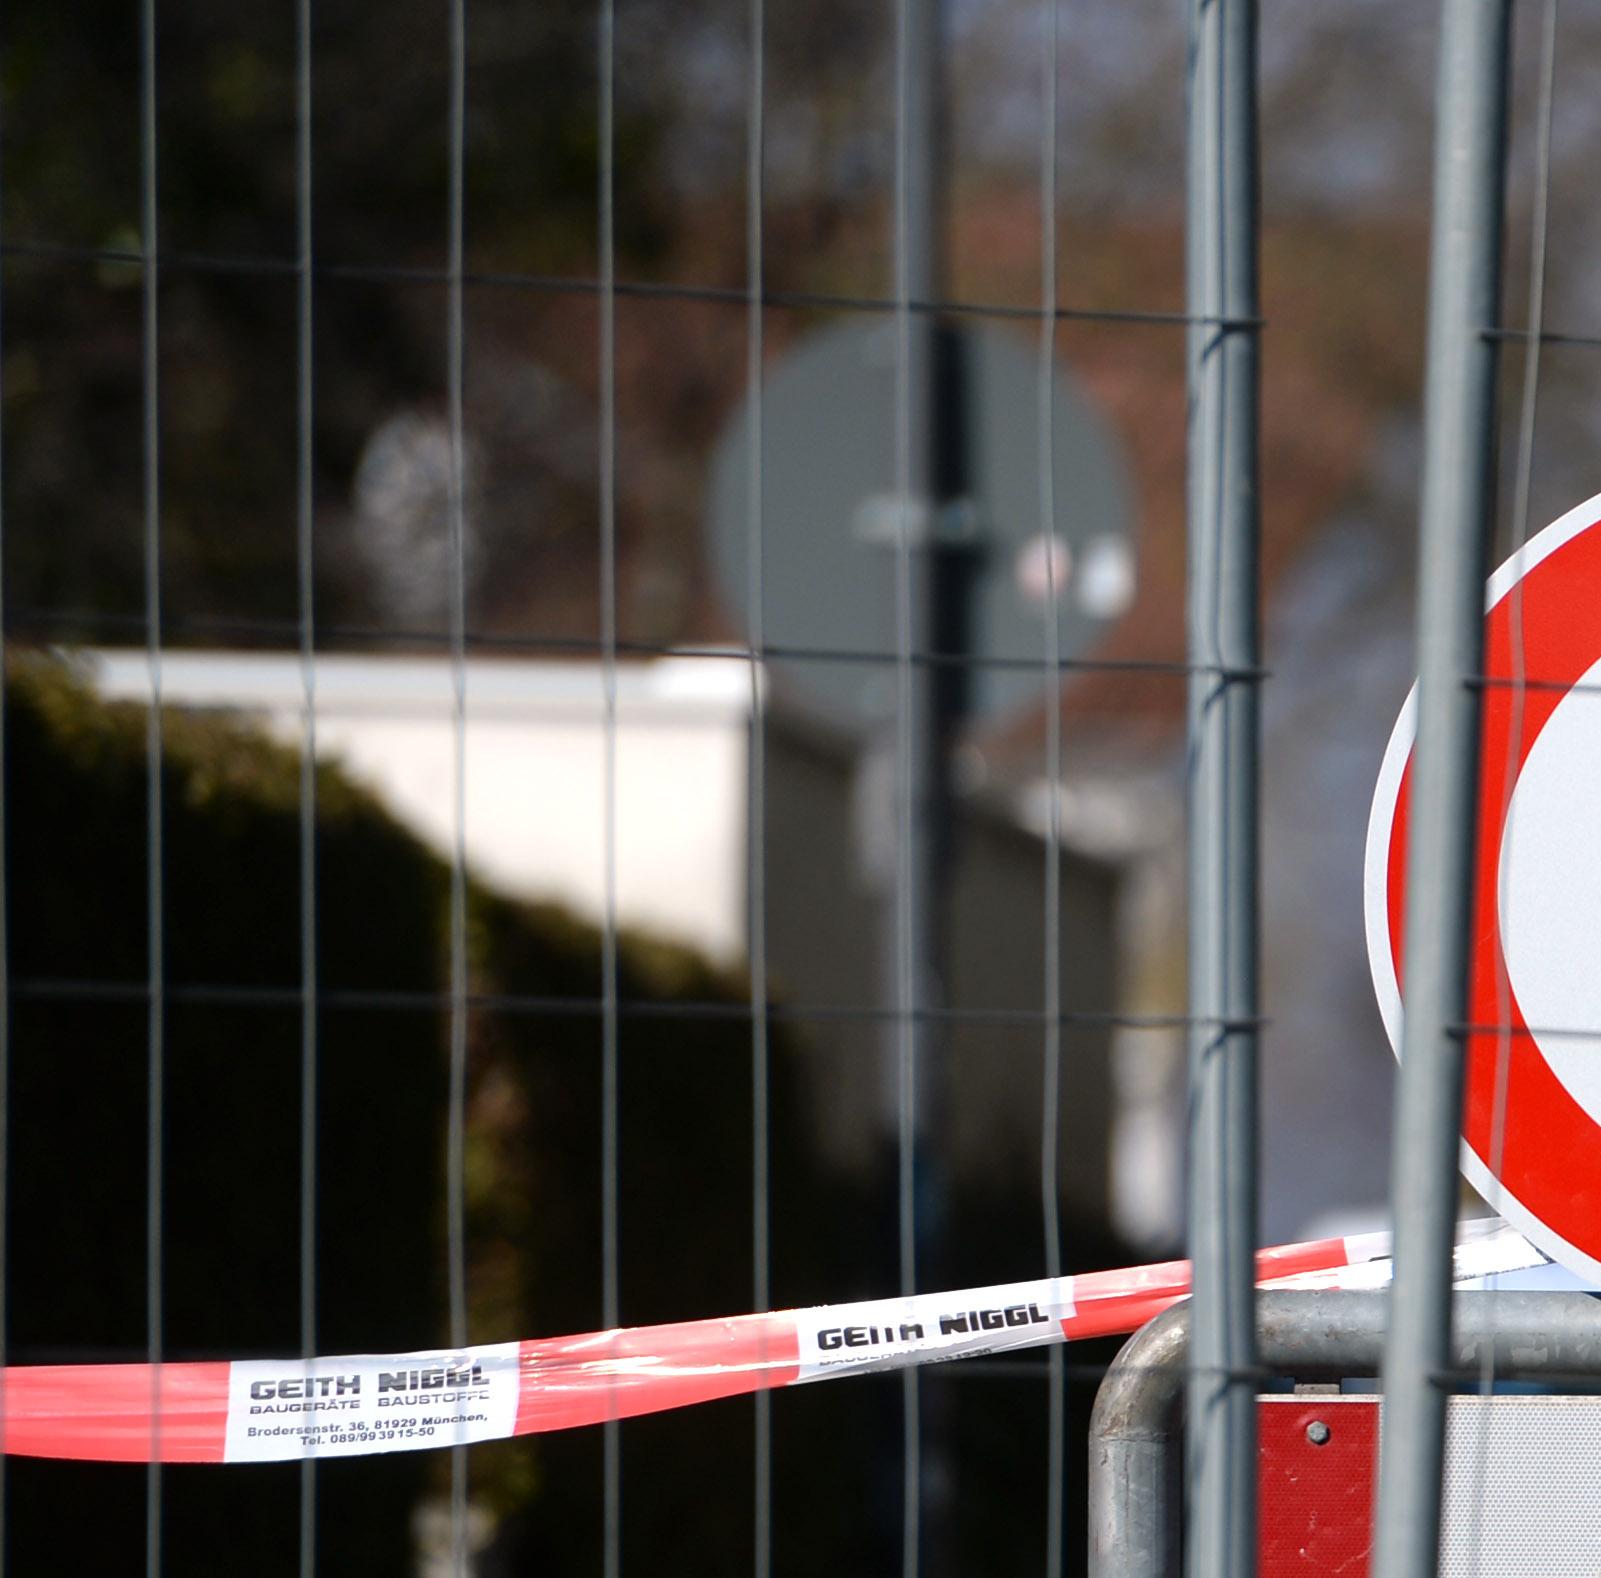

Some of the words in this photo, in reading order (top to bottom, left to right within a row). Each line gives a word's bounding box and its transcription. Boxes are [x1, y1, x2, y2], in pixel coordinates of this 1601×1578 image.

[939, 1302, 1049, 1336] NIGGL
[250, 1374, 361, 1400] GEITH
[378, 1365, 490, 1393] NIGGL
[249, 1399, 361, 1415] BAUGERÄTE
[247, 1422, 344, 1437] Brodersenstr.
[348, 1420, 370, 1433] 36,
[374, 1417, 417, 1429] 81929
[421, 1413, 488, 1427] München,
[301, 1435, 326, 1446] Tel.
